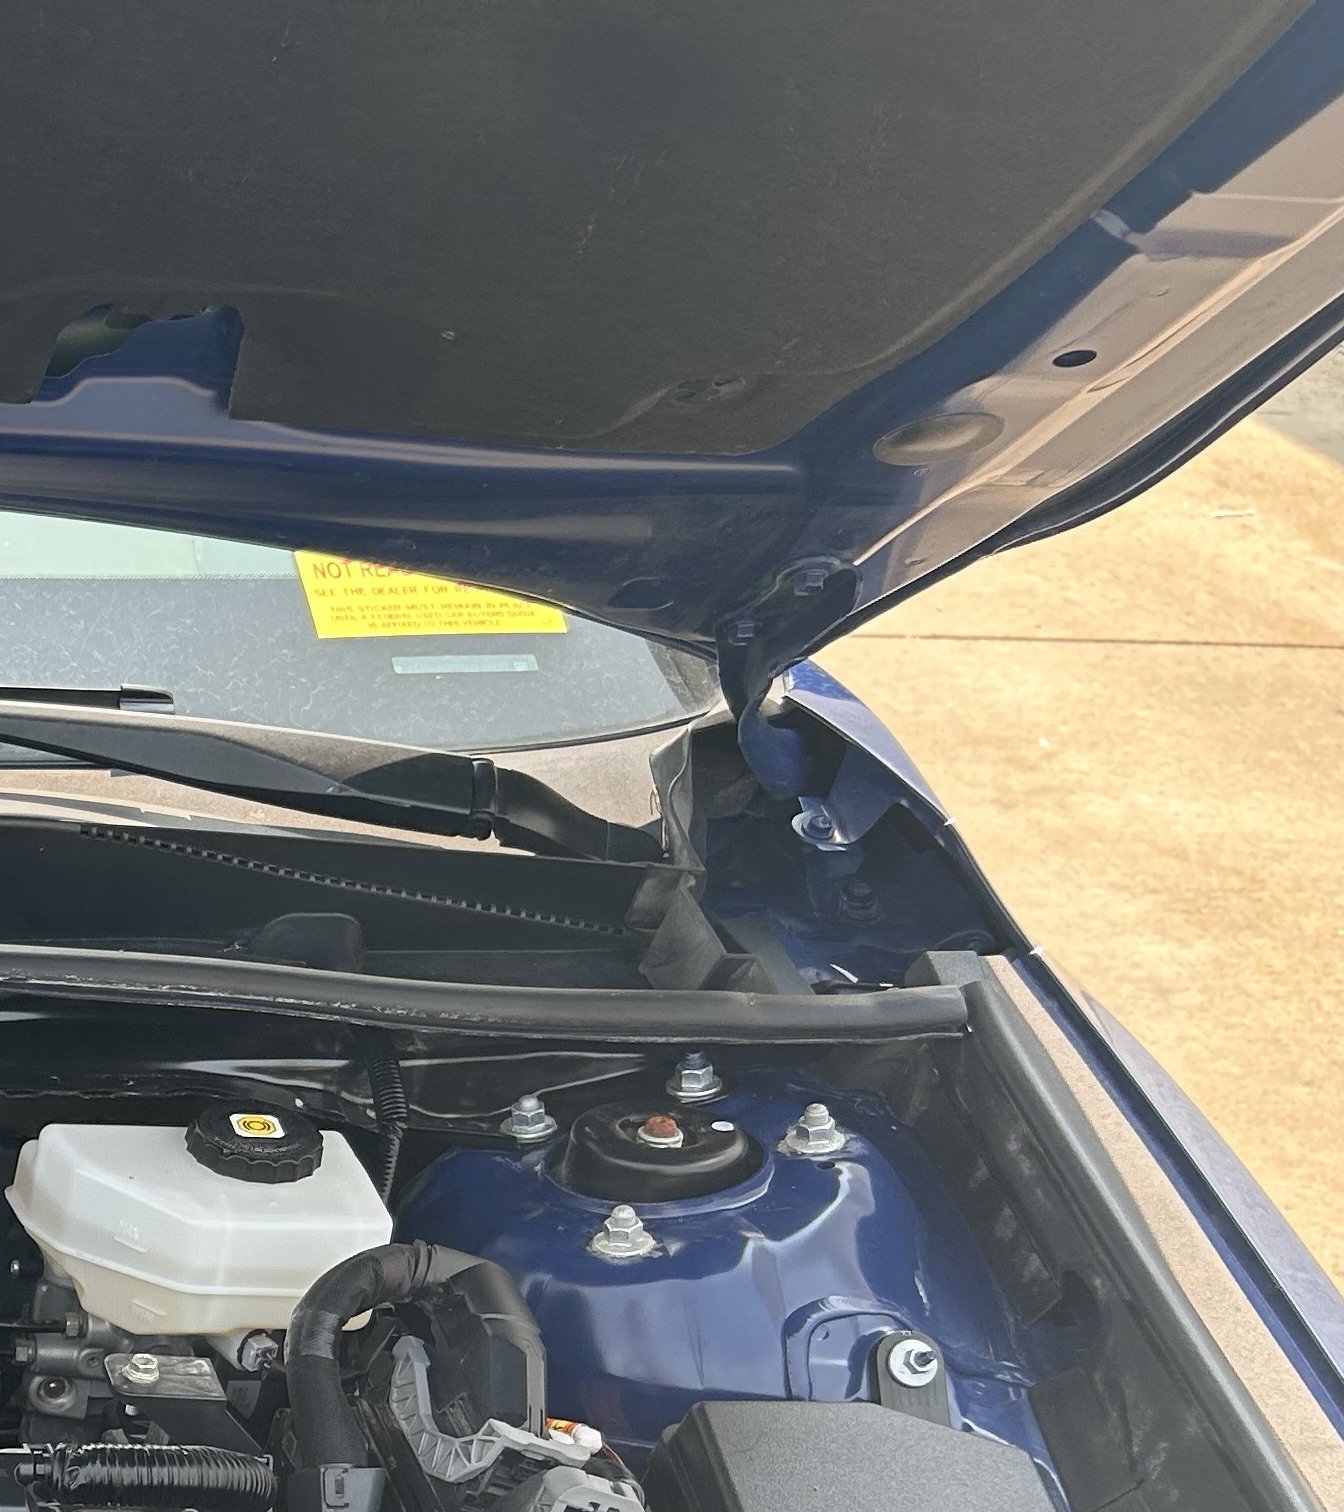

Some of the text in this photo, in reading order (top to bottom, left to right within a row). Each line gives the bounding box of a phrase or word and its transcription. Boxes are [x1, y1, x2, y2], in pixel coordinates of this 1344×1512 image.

[312, 561, 352, 579] NOT
[314, 589, 336, 598] SEE
[343, 587, 364, 597] THE
[371, 586, 417, 596] DEALER
[423, 585, 449, 594] FOR
[330, 605, 354, 613] THIS
